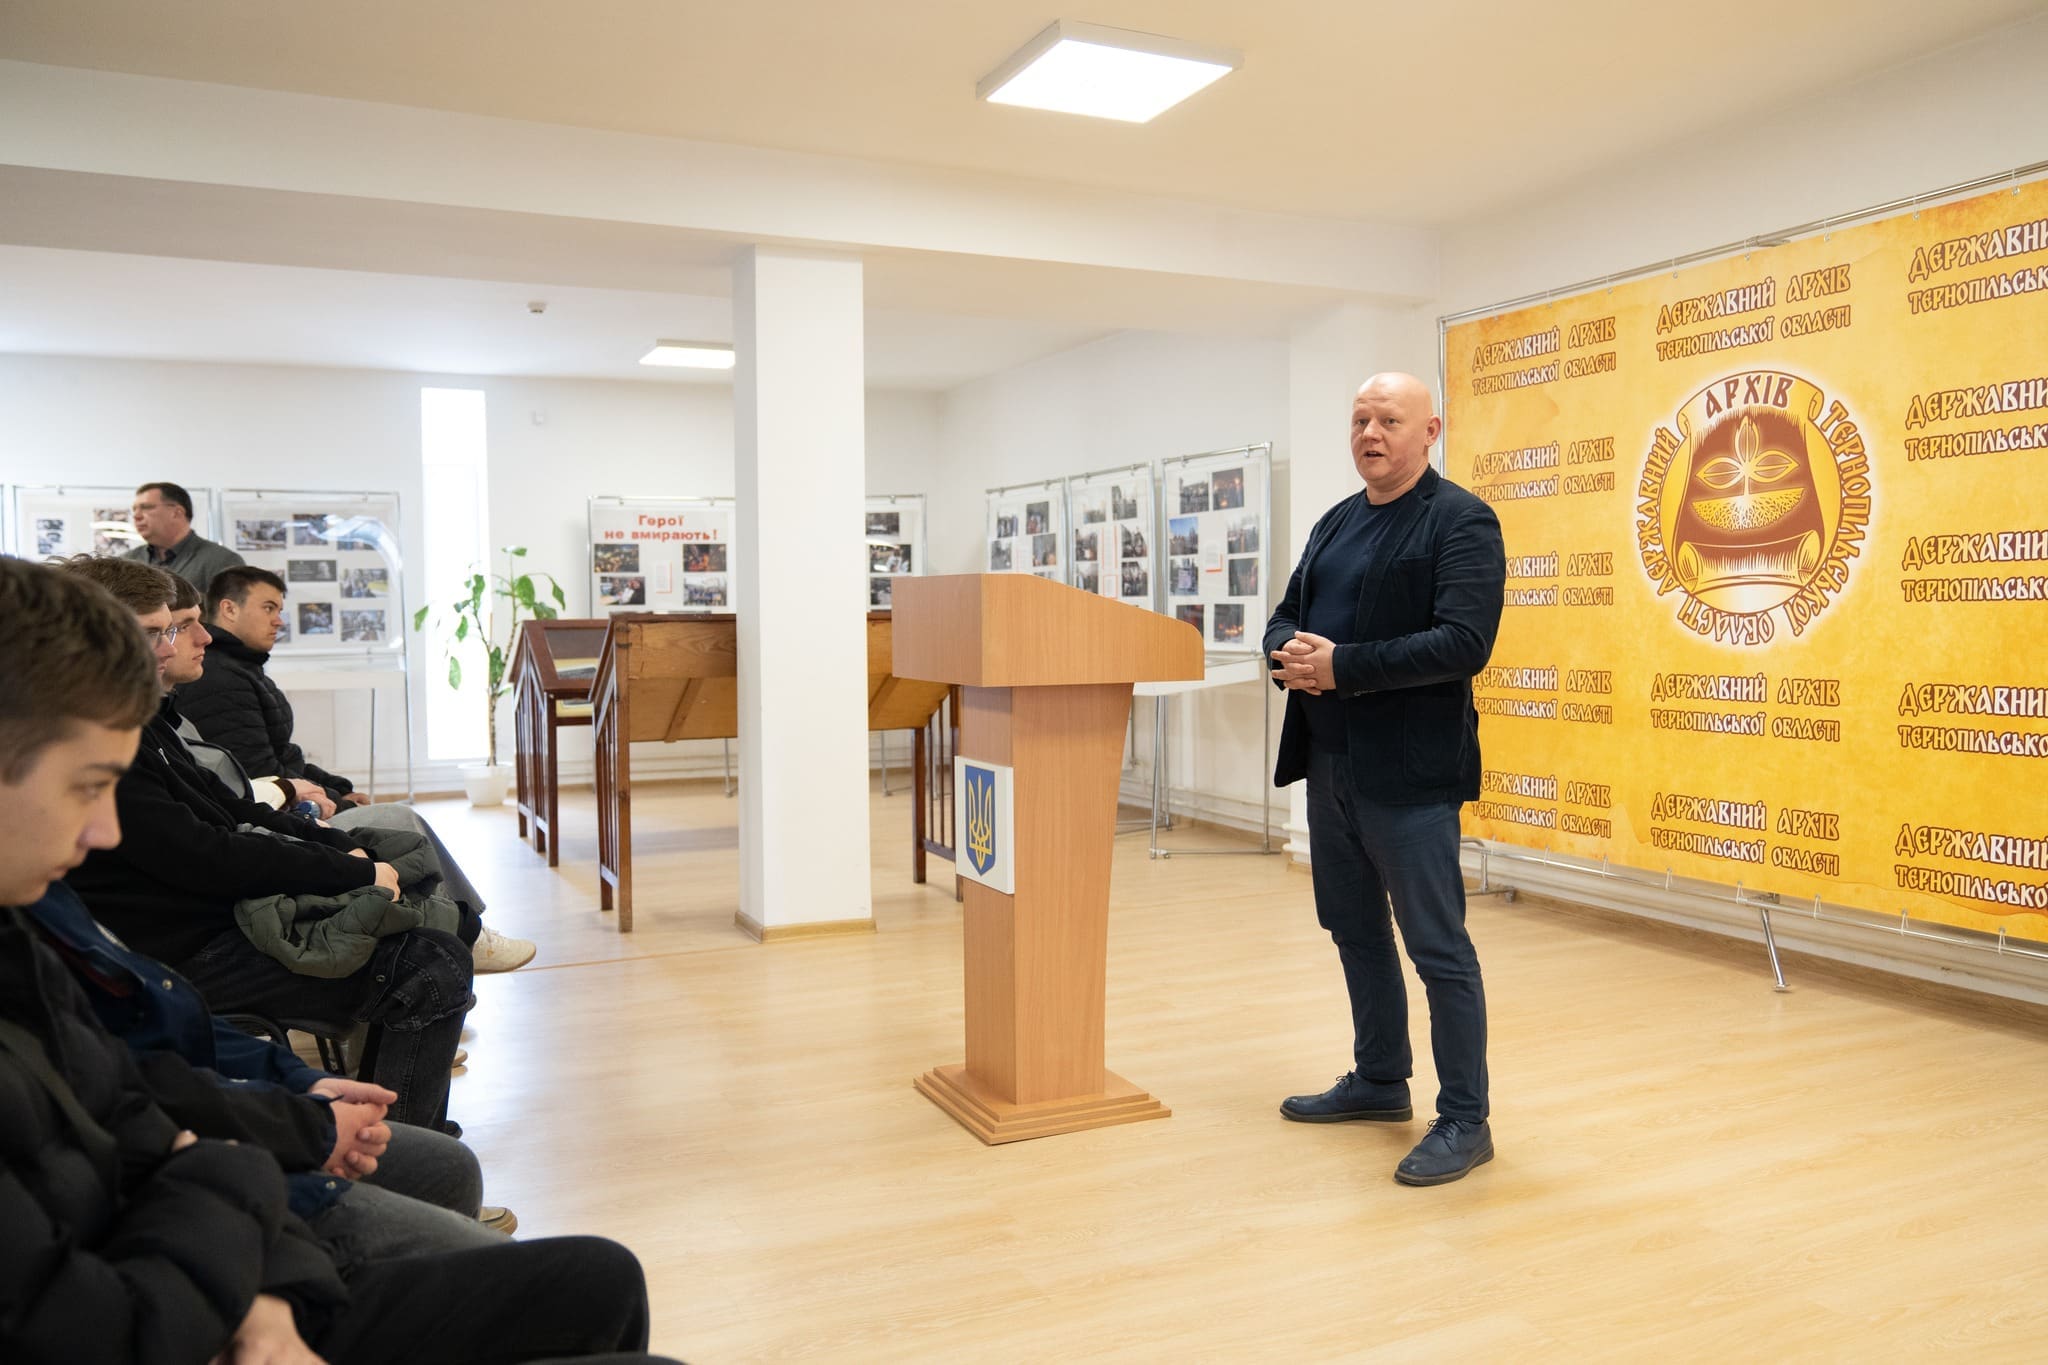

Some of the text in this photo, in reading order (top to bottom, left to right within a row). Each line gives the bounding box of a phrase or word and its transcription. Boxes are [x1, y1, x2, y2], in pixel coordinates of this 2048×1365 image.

[1786, 264, 1850, 303] АРХІВ
[1568, 316, 1616, 349] АРХІВ
[1780, 304, 1851, 339] ОБЛАСТІ
[1564, 352, 1616, 379] ОБЛАСТІ
[1705, 374, 1794, 419] АРХІВ
[1567, 437, 1615, 465] АРХІВ
[1563, 472, 1615, 495] ОБЛАСТІ
[604, 530, 625, 540] не
[638, 514, 684, 528] Герої
[1566, 552, 1613, 577] АРХІВ
[1563, 586, 1613, 607] ОБЛАСТІ
[1677, 595, 1775, 646] ОБЛАСТІ
[1566, 669, 1612, 694] АРХІВ
[1777, 677, 1840, 706] АРХІВ
[1562, 703, 1612, 724] ОБЛАСТІ
[1898, 682, 2048, 718] ДЕРЖАВНИ
[1772, 717, 1840, 742] ОБЛАСТІ
[1481, 770, 1611, 808] ЕРЖАВНИЙ АРХІВ
[1561, 814, 1611, 838] ОБЛАСТІ
[1777, 808, 1839, 841] АРХІВ
[1772, 846, 1839, 876] ОБЛАСТІ
[1894, 864, 2048, 909] ТЕРНОПІЛЬСЬКО
